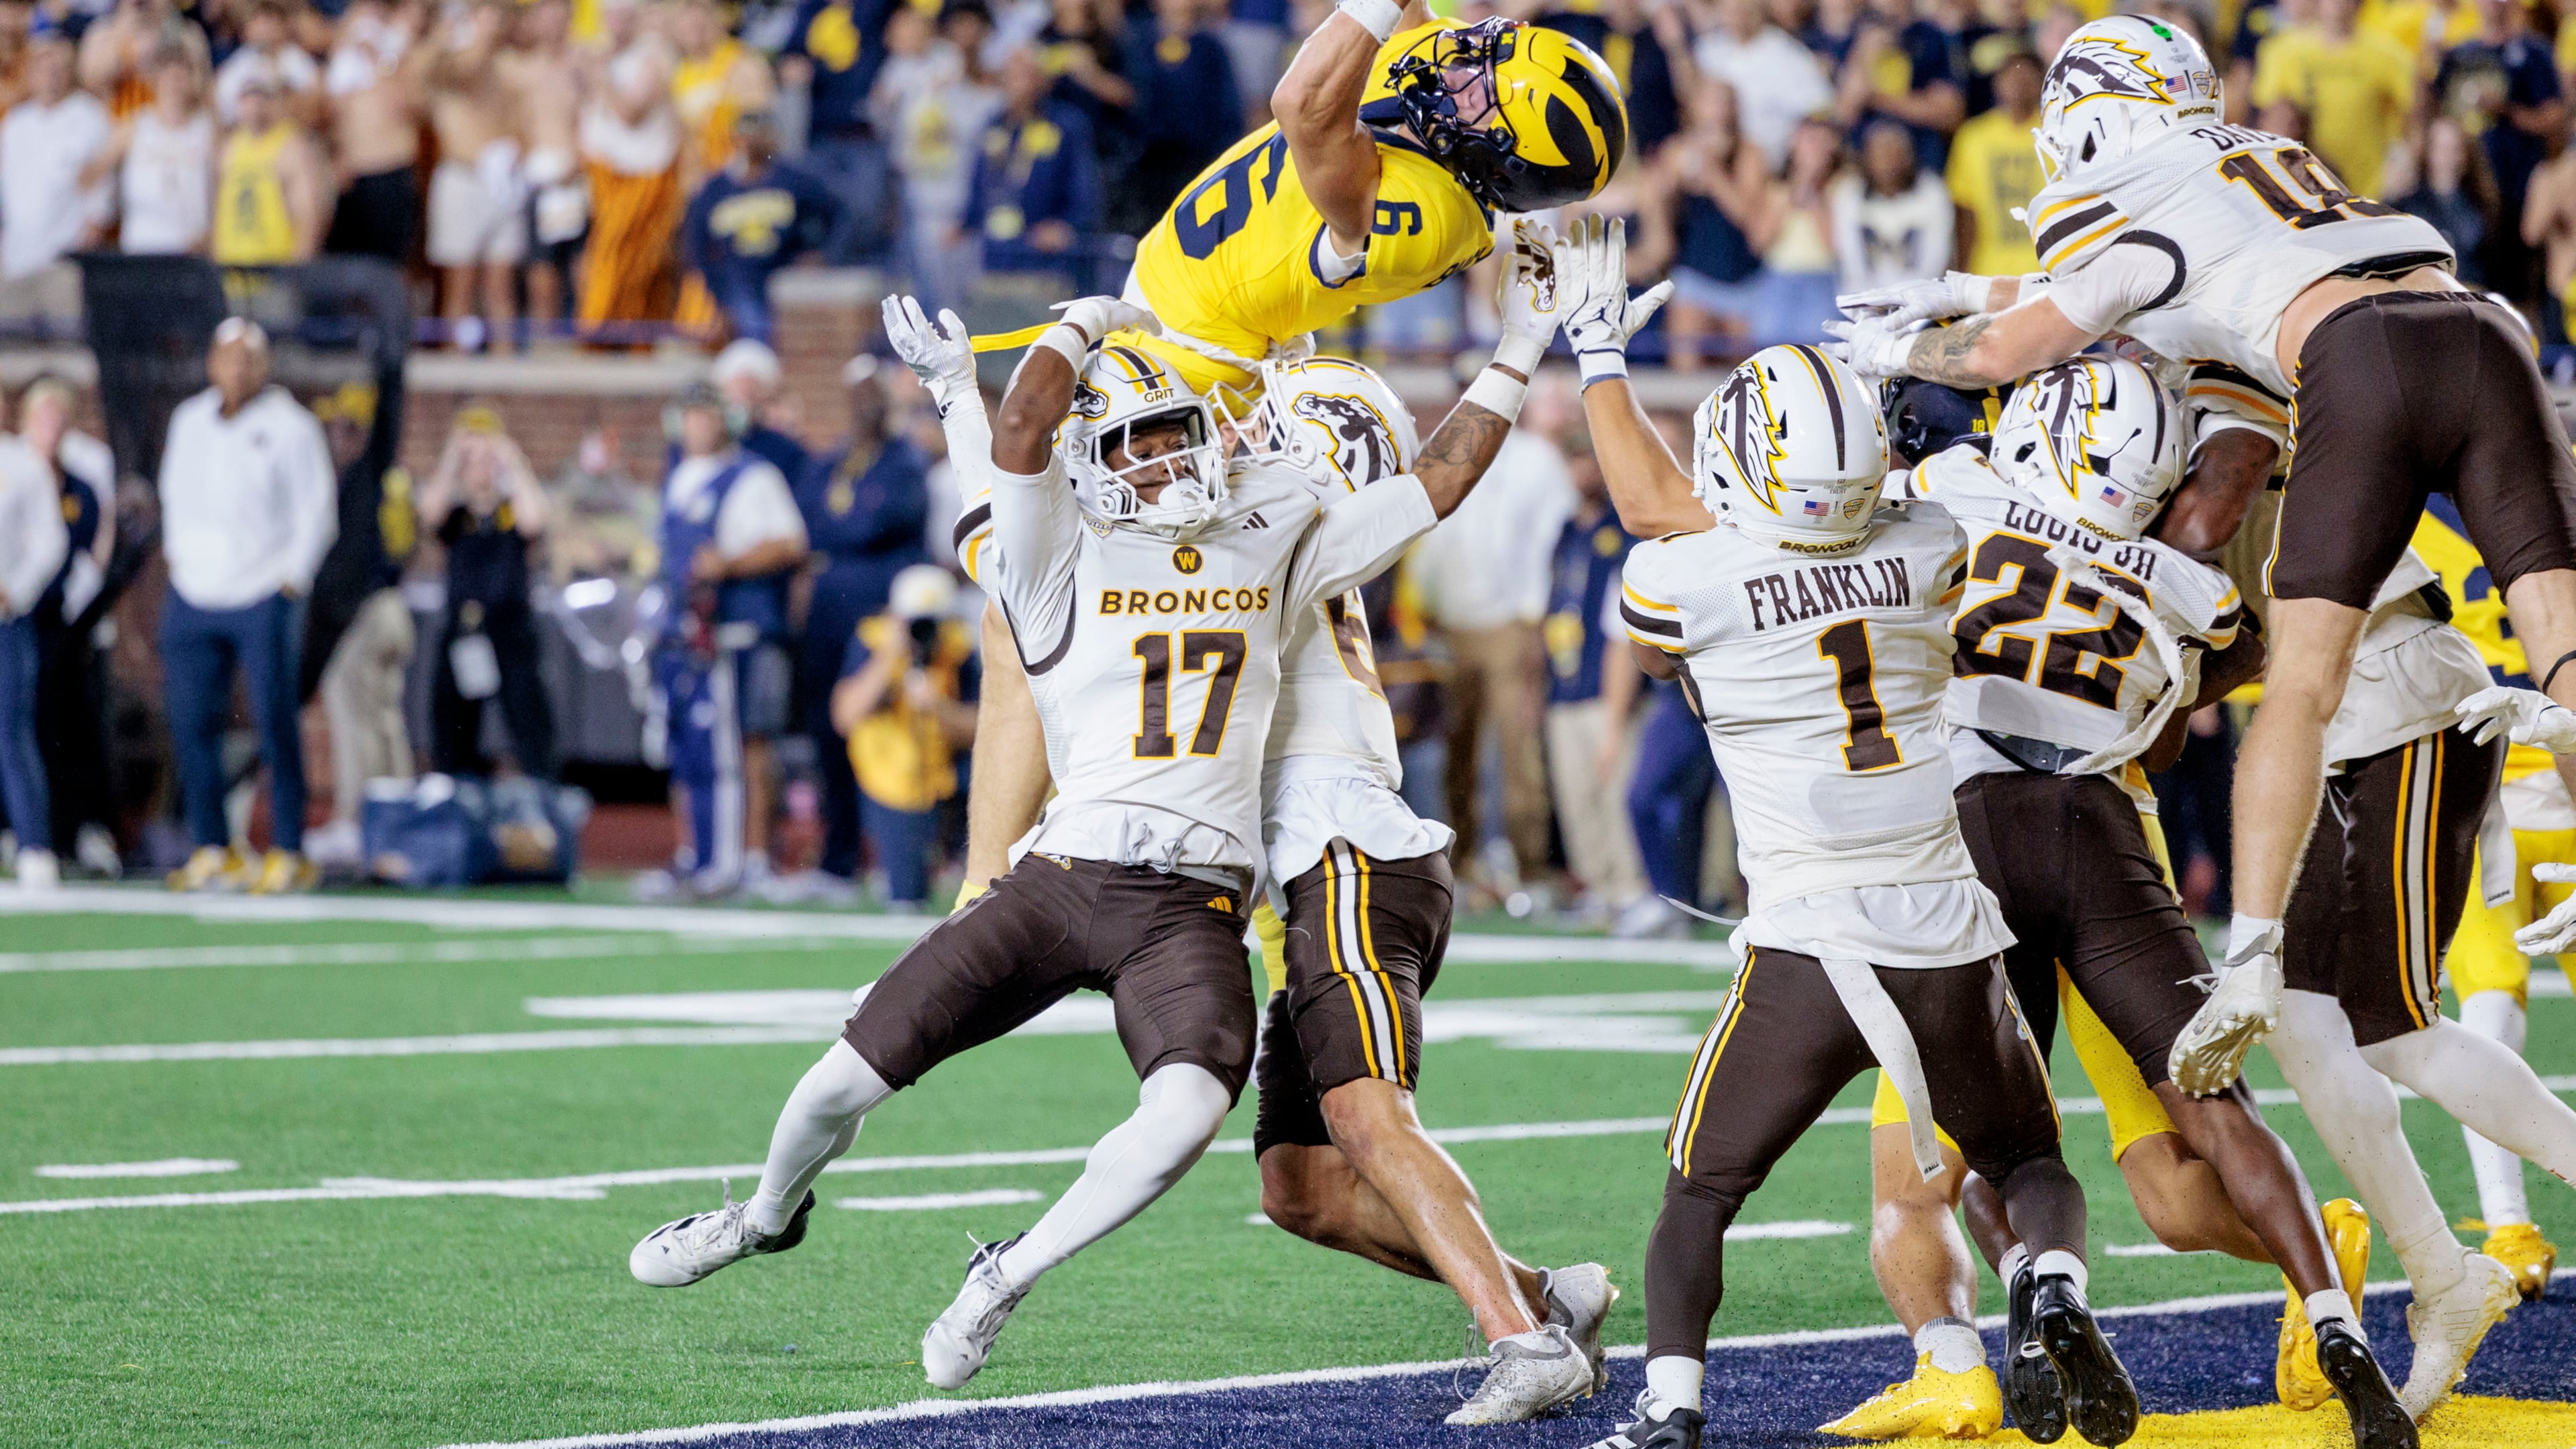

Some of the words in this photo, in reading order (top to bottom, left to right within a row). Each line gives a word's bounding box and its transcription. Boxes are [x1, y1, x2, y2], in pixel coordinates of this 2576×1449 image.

[2177, 106, 2216, 119] BRONCOS
[1144, 388, 1175, 403] GRIT
[1972, 419, 1986, 433] 18
[1778, 537, 1860, 554] BRONCOS
[1098, 584, 1271, 616] BRONCOS
[1743, 557, 1911, 632] FRANKLIN
[1951, 529, 2154, 712] 22
[1132, 628, 1250, 761] 17
[1815, 617, 1905, 772] 1
